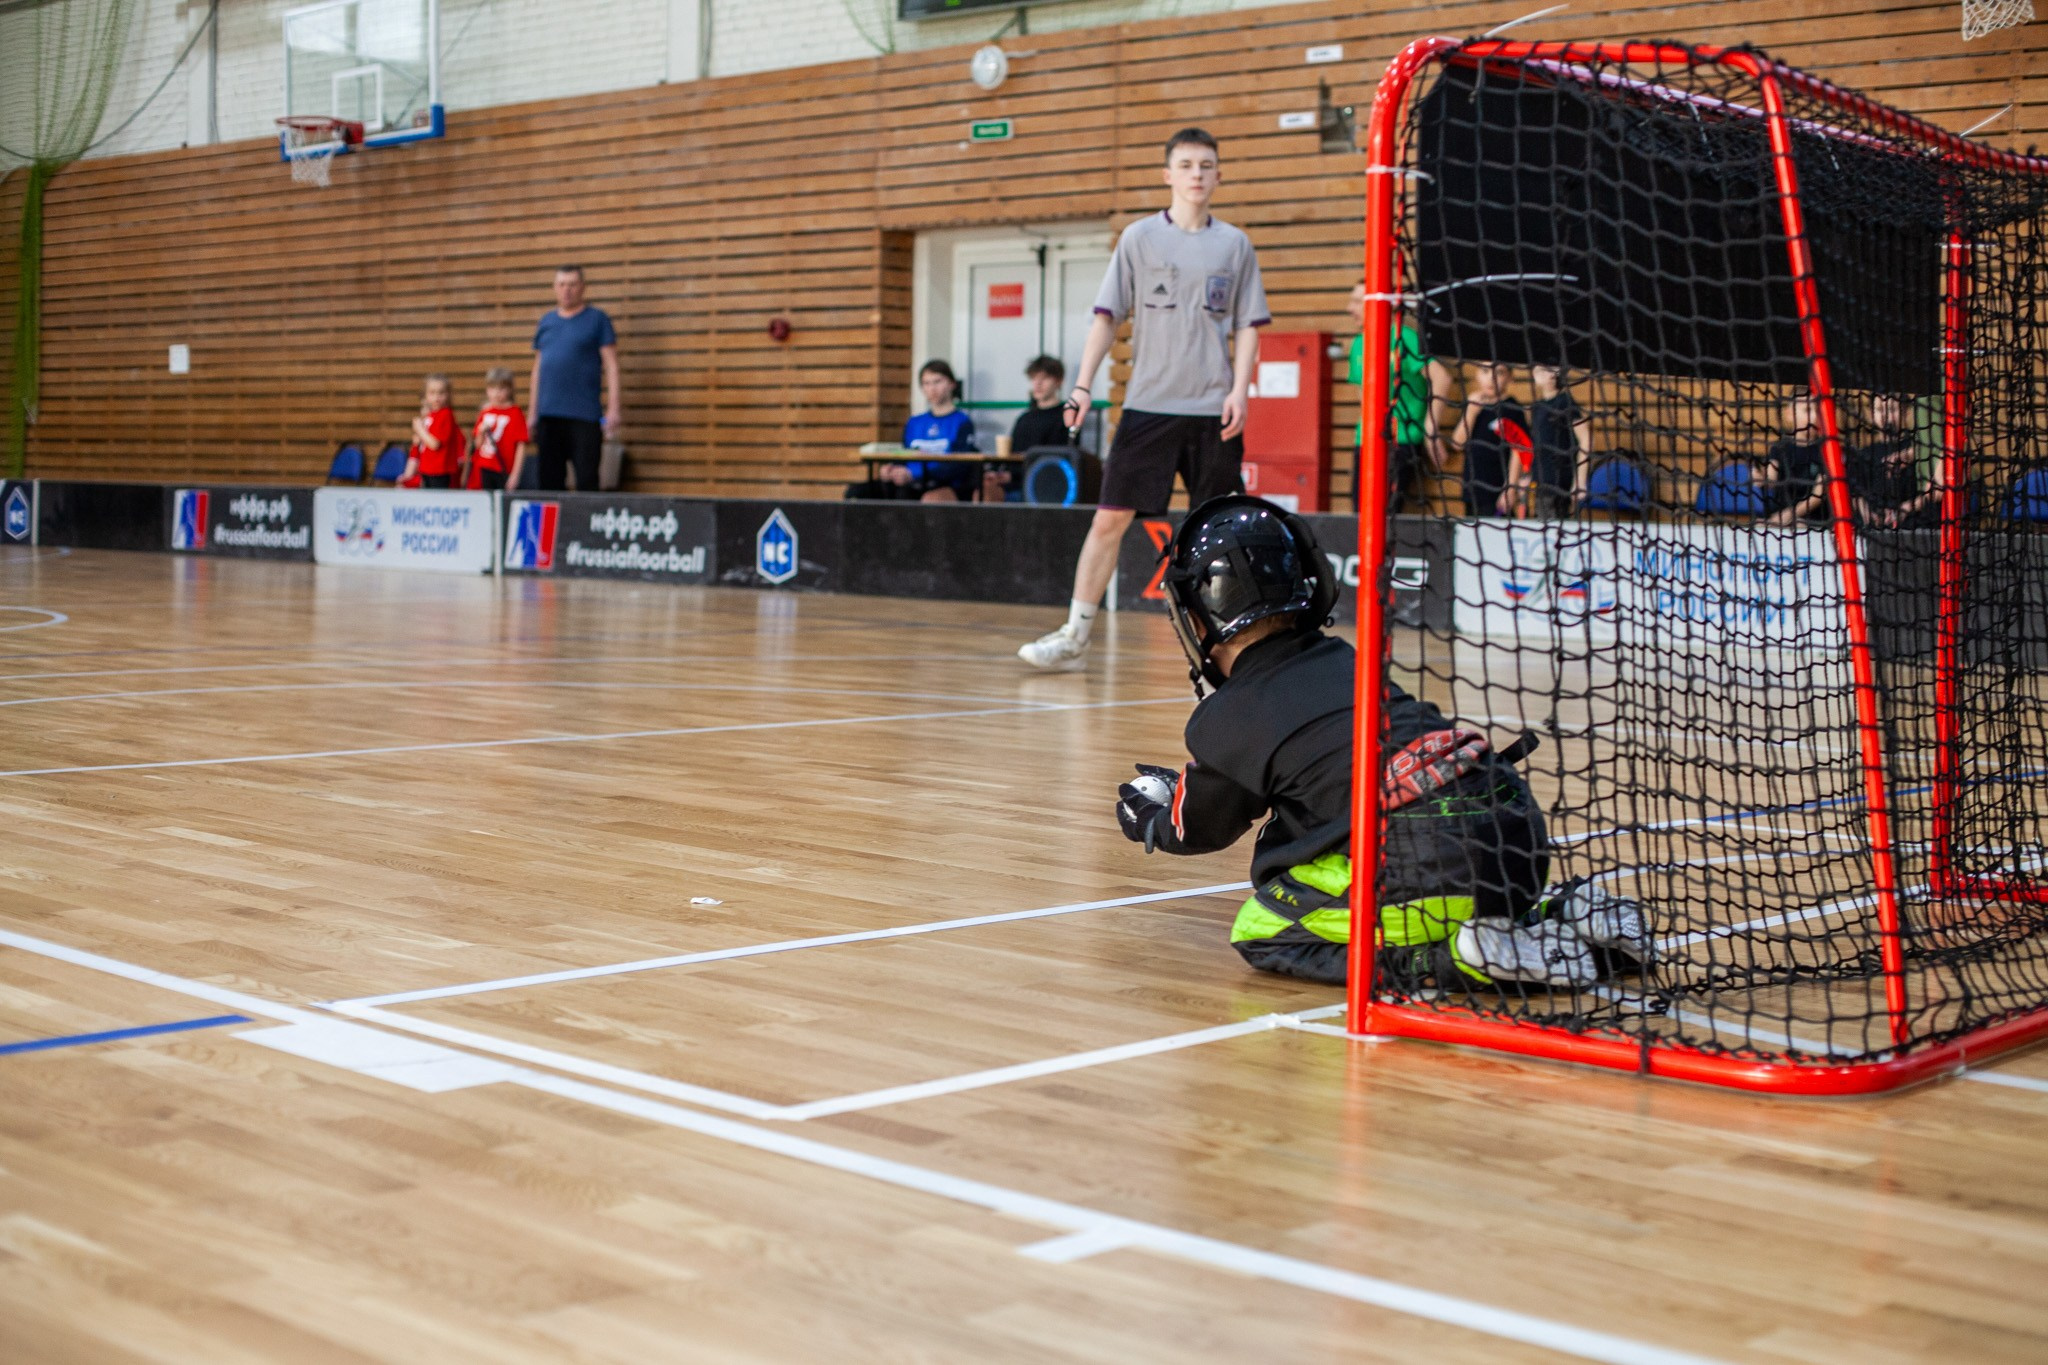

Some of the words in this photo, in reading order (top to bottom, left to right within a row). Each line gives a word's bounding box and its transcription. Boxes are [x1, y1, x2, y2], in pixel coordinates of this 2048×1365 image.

[391, 505, 471, 528] МИНСПОРТ
[590, 508, 679, 542] нффр.рф
[213, 523, 310, 549] #russiafloorball
[401, 532, 460, 554] РОССИИ
[565, 540, 707, 573] #russiafloorball
[1633, 548, 1815, 585] МИНСПОРТ
[1658, 590, 1787, 625] РОССИИ
